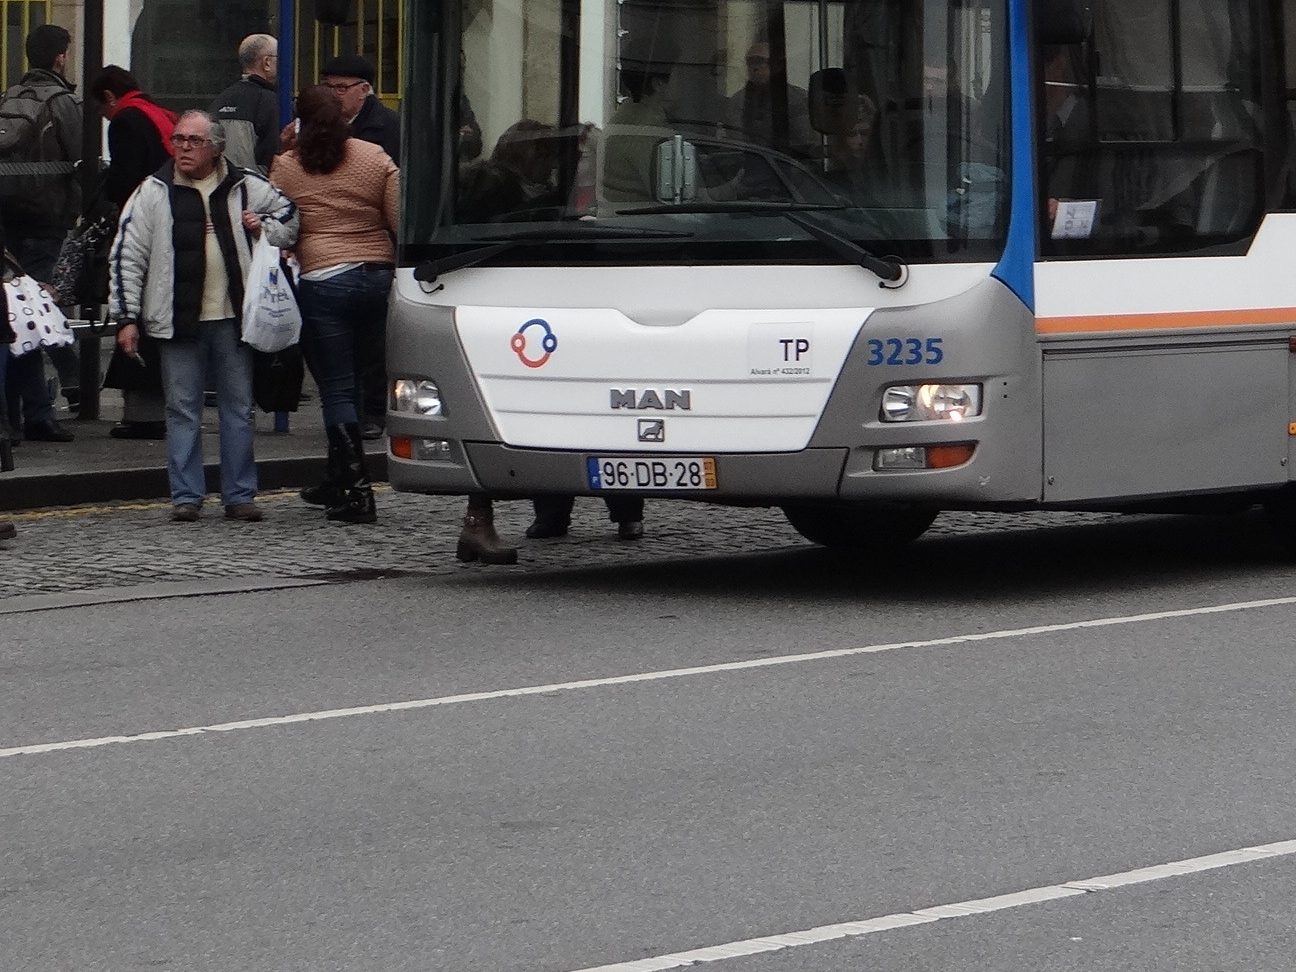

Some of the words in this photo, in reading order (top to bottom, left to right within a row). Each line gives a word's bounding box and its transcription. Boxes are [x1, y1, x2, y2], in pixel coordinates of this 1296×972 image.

[779, 338, 810, 362] TP
[867, 337, 944, 366] 3235
[610, 388, 692, 410] MAN
